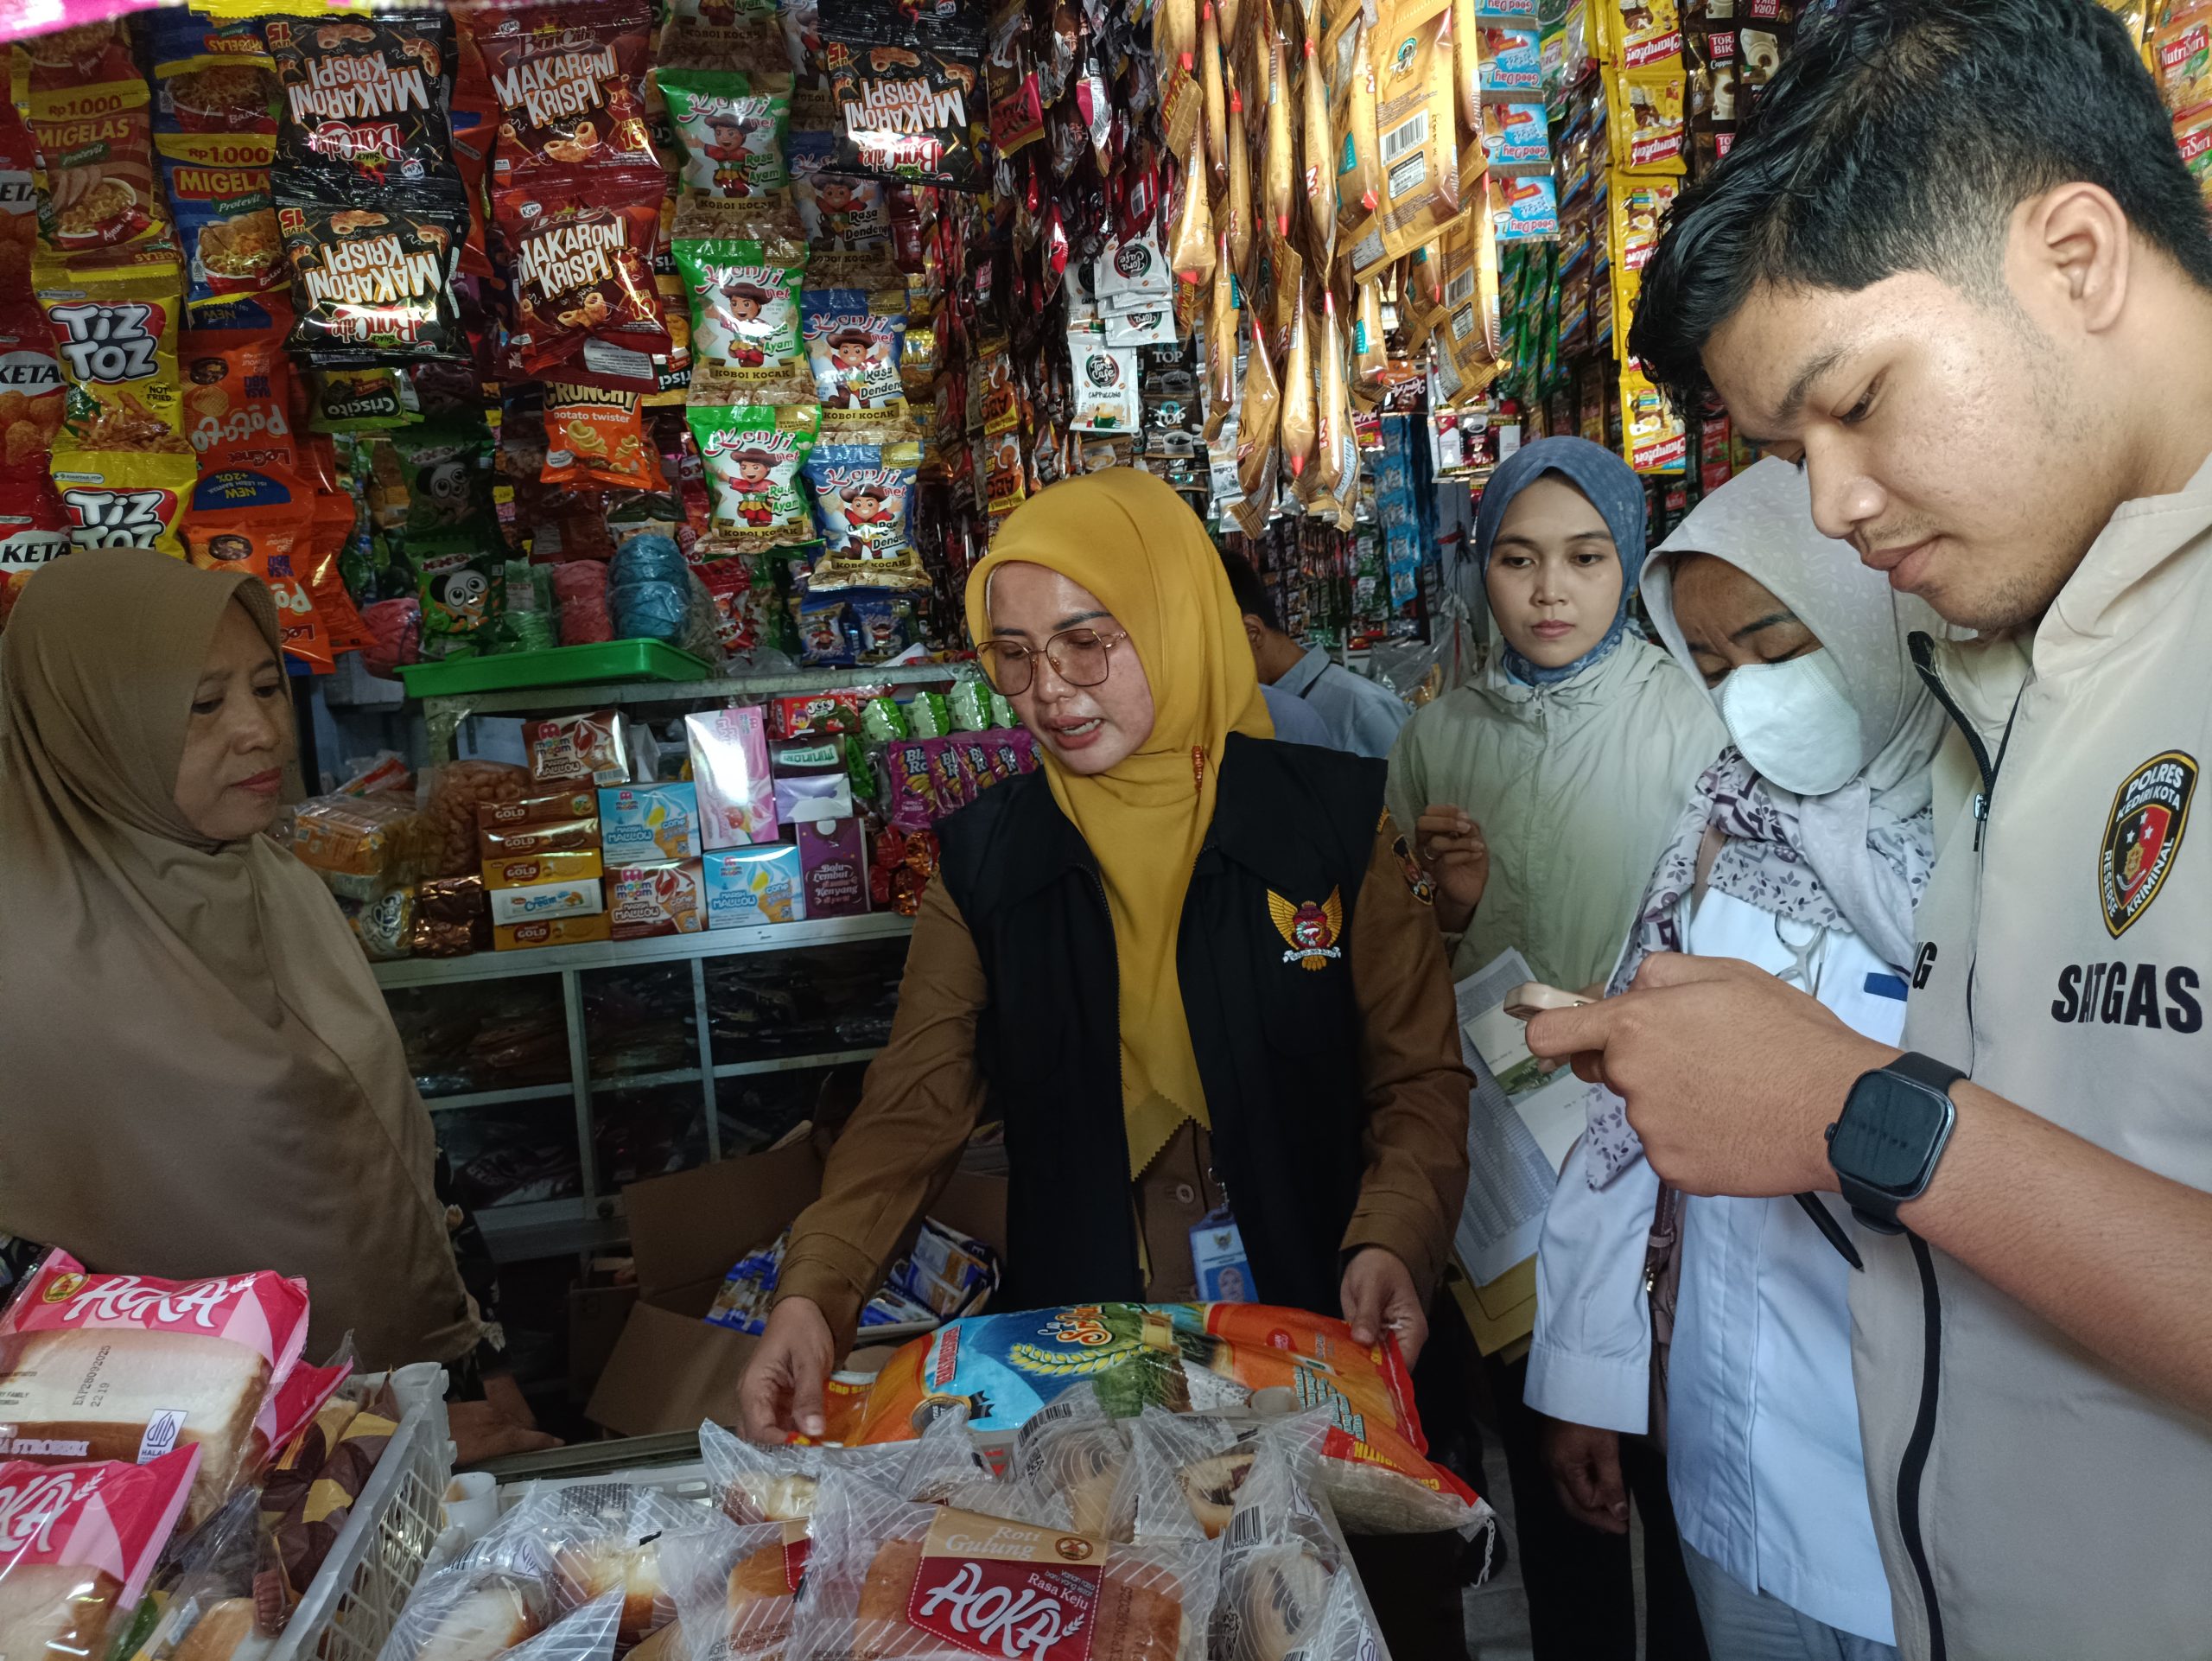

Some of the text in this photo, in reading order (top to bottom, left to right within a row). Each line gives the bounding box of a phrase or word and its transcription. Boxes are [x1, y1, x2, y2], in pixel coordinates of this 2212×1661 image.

[1626, 33, 1681, 61] Champion
[2162, 30, 2205, 68] NutriSari
[308, 54, 388, 87] KRISPI
[1495, 71, 1540, 85] Good Day
[492, 46, 620, 111] MAKARONI
[288, 67, 429, 124] MAKARONI
[863, 76, 933, 110] KRISPI
[525, 75, 602, 128] KRISPI
[842, 89, 967, 136] MAKARONI
[749, 117, 776, 129] net
[1503, 145, 1548, 159] Good Day
[745, 152, 774, 168] Rasa
[748, 169, 779, 185] Ayam
[700, 198, 777, 211] KOBOI KOCAK
[848, 208, 878, 225] Rasa
[1510, 220, 1555, 232] Good Day
[322, 235, 406, 274] KRISPI
[518, 216, 627, 284] MAKARONI
[305, 252, 442, 306] MAKARONI
[540, 249, 613, 301] KRISPI
[766, 287, 790, 300] net
[869, 331, 895, 345] net
[764, 338, 794, 354] Ayam
[1153, 351, 1184, 363] TOP
[714, 367, 791, 379] KOBOI KOCAK
[1091, 368, 1116, 380] Cafe
[149, 385, 168, 394] NOT
[1088, 391, 1122, 399] CAPPUCCINO
[554, 411, 631, 423] potato twister
[823, 409, 895, 421] KOBOI KOCAK
[192, 404, 289, 452] Potato
[774, 449, 800, 463] net
[225, 487, 257, 499] NEW
[882, 486, 907, 499] net
[772, 498, 800, 514] Ayam
[722, 526, 798, 538] KOBOI KOCAK
[869, 557, 906, 568] KOCAK
[2125, 762, 2184, 801] POLRES
[2115, 787, 2182, 822] KEDIRI KOTA
[494, 809, 526, 819] GOLD
[505, 837, 535, 847] GOLD
[607, 831, 653, 843] MALLOW
[506, 866, 537, 876] GOLD
[822, 863, 845, 873] Bolu
[2103, 849, 2119, 918] RESERSE
[2126, 837, 2174, 917] KRIMINAL
[815, 883, 859, 897] Kenyang
[713, 897, 756, 909] MALLOW
[615, 908, 660, 920] MALLOW
[517, 928, 547, 939] GOLD
[2050, 960, 2203, 1034] SATGAS
[995, 1525, 1042, 1543] Roti
[945, 1533, 1036, 1559] Gulung
[1045, 1569, 1061, 1582] baru
[1059, 1575, 1078, 1592] yang
[1027, 1572, 1089, 1611] Rasa Keju
[920, 1562, 1062, 1661] AOKA
